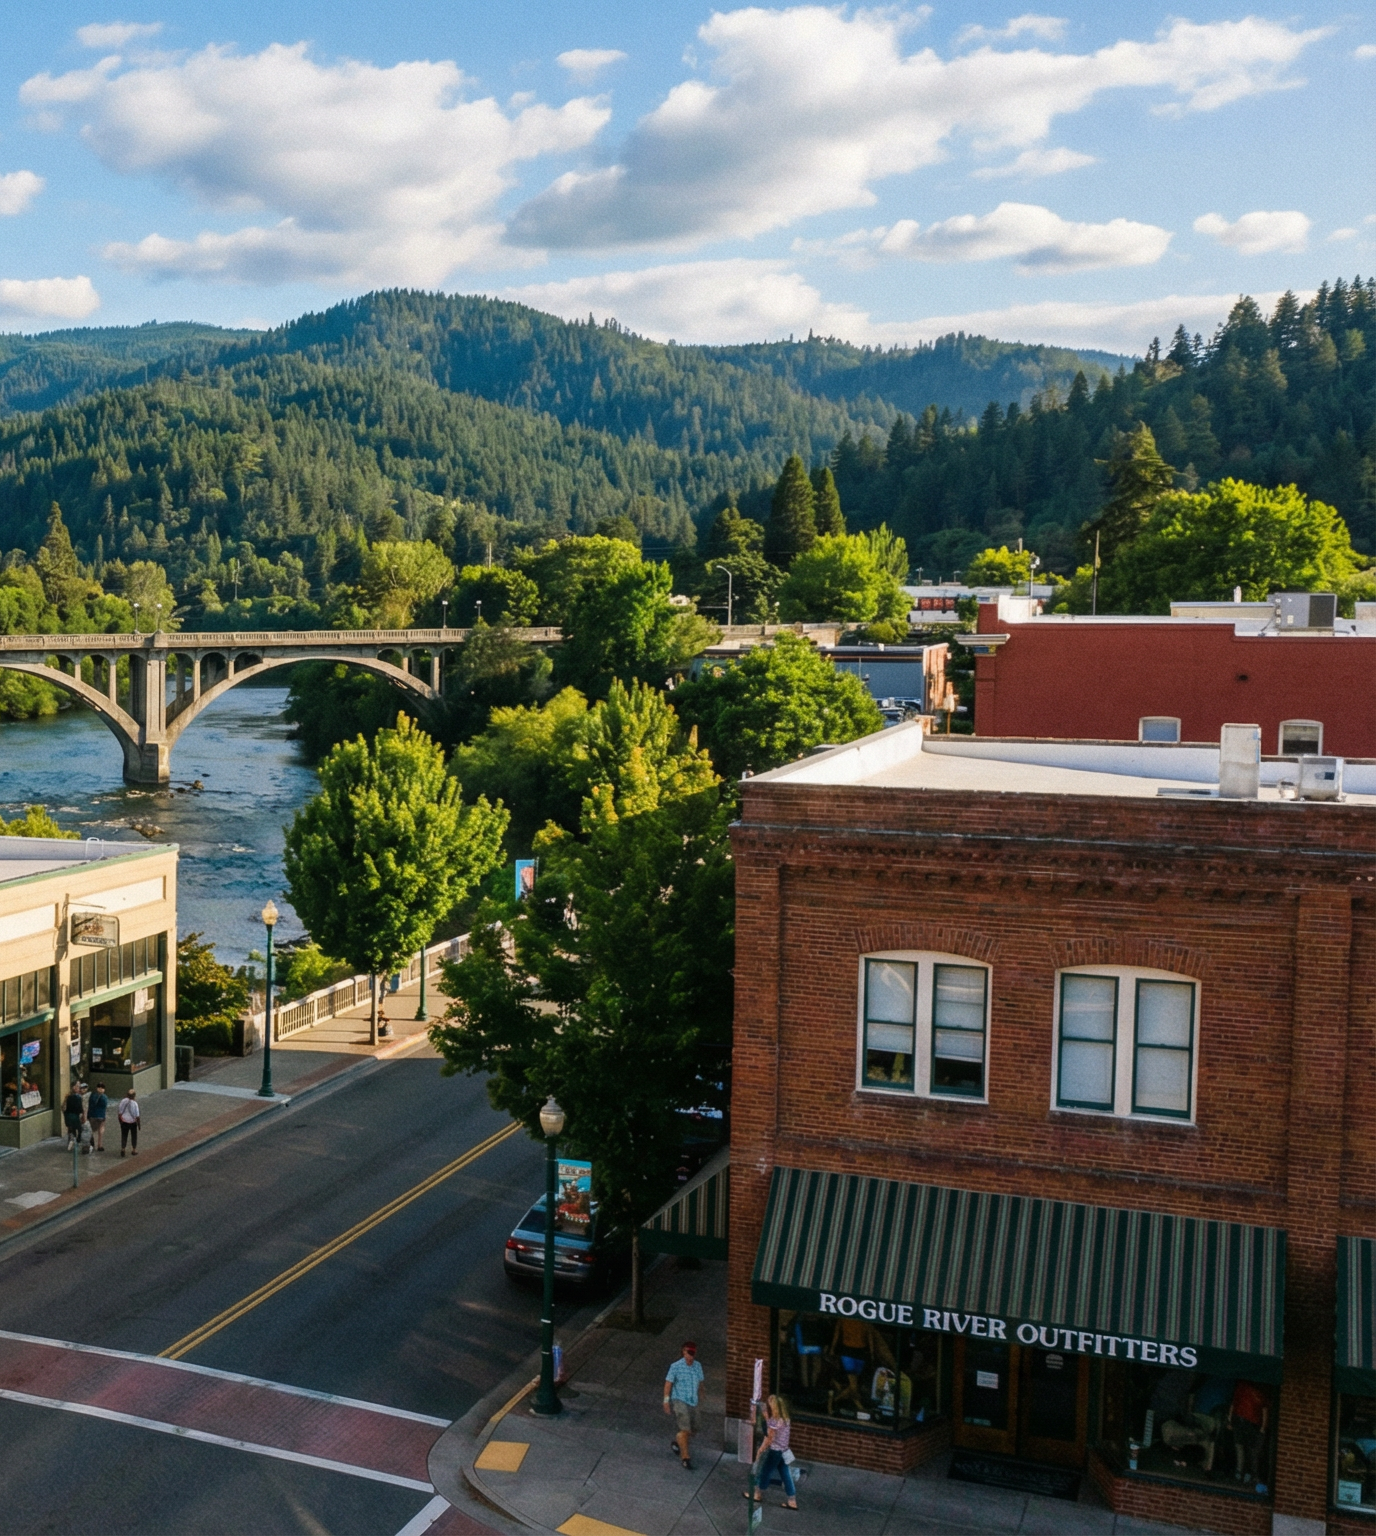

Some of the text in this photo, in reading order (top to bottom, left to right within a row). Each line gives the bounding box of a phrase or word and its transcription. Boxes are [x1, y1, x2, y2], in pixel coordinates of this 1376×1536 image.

[819, 1293, 914, 1325] ROGUE
[923, 1308, 1007, 1340] RIVER
[1017, 1323, 1198, 1368] OUTFITTERS
